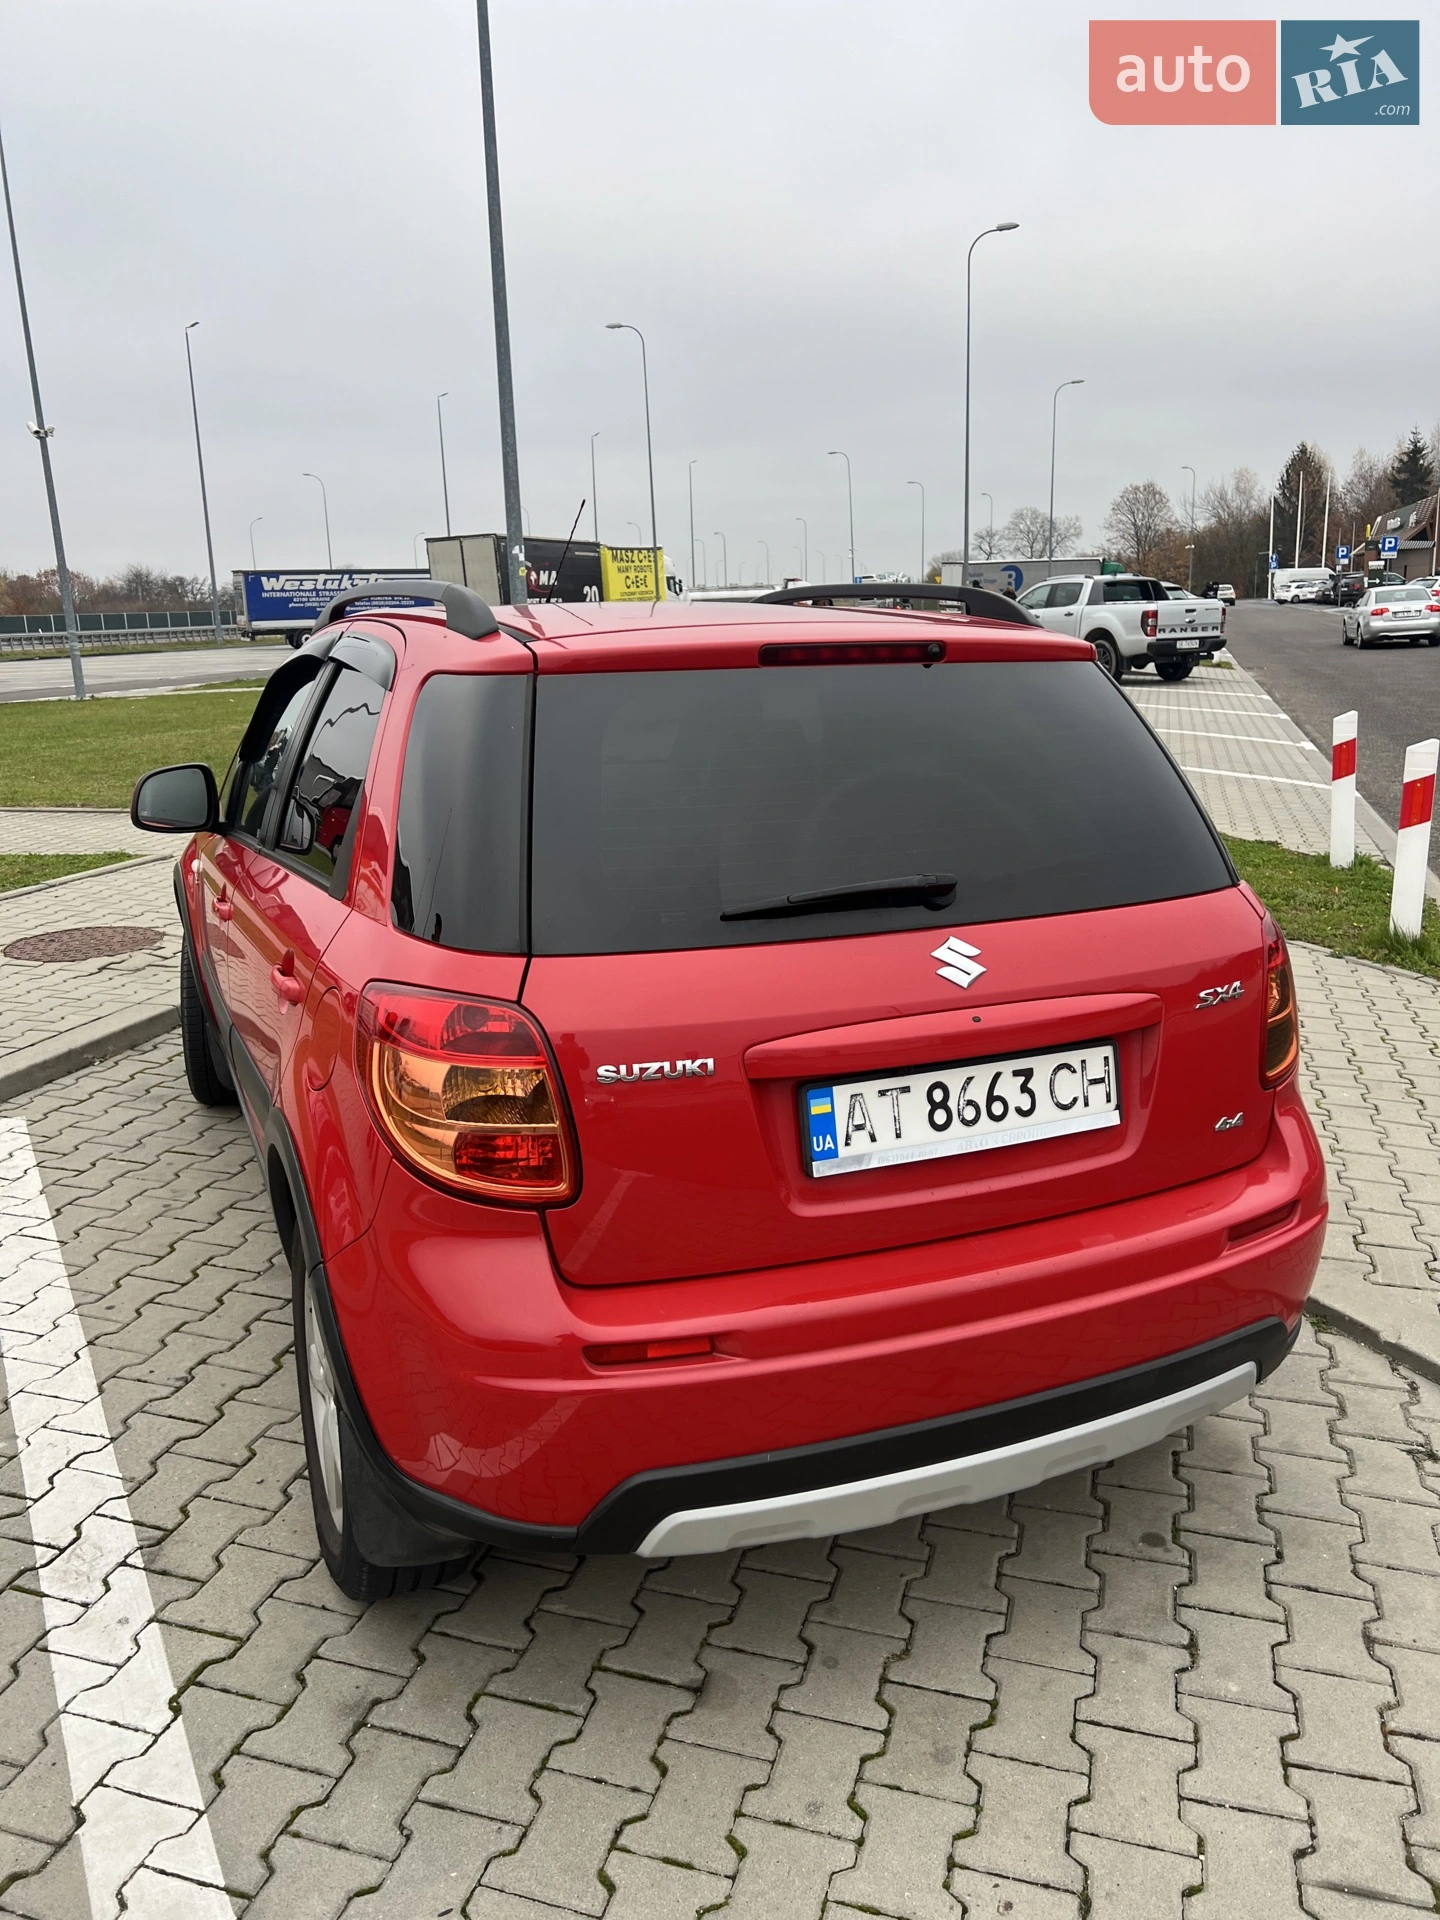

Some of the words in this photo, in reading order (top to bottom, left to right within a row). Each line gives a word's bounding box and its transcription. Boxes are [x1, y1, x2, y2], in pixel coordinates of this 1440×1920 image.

[1385, 538, 1395, 550] P
[611, 550, 635, 563] MASZ
[1338, 548, 1347, 557] P
[1158, 626, 1219, 634] RANGER
[1195, 981, 1245, 1009] SX4
[597, 1058, 714, 1083] SUZUKI
[844, 1086, 911, 1147] AT
[926, 1068, 1037, 1132] 8663
[1048, 1055, 1112, 1111] CH
[813, 1134, 835, 1151] UA
